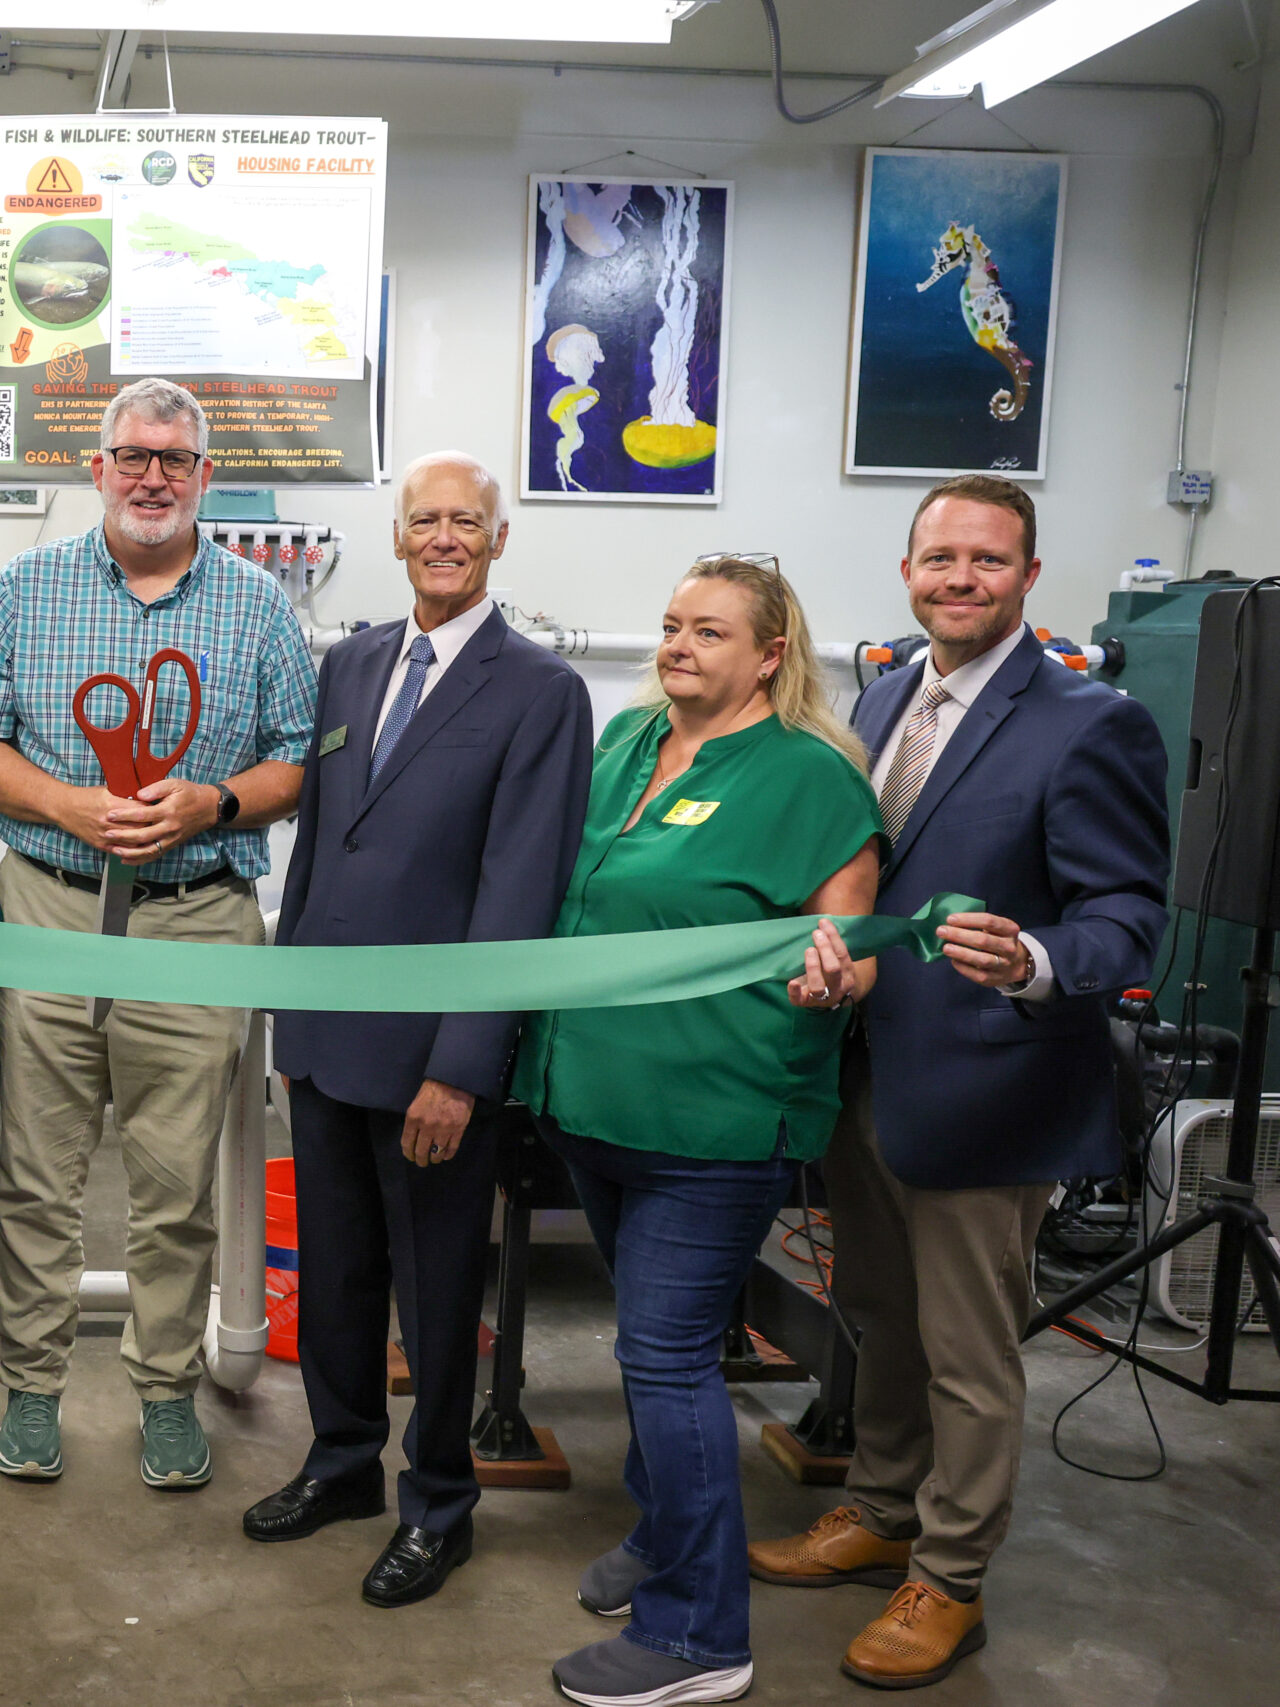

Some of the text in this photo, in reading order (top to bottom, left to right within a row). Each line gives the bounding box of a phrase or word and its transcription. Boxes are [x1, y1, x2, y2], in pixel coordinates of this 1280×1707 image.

[5, 129, 37, 143] FISH
[44, 129, 54, 143] &
[61, 129, 131, 143] WILDLIFE:
[137, 128, 216, 143] SOUTHERN
[222, 130, 310, 145] STEELHEAD
[237, 156, 374, 173] HOUSING FACILITY
[9, 197, 97, 208] ENDANGERED
[33, 384, 86, 395] SAVING
[91, 383, 117, 393] THE
[203, 382, 286, 394] STEELHEAD
[291, 385, 338, 397] TROUT
[242, 400, 273, 408] DISTRICT
[303, 402, 326, 410] SANTA
[228, 412, 257, 420] PROVIDE
[212, 424, 250, 432] SOUTHERN
[252, 424, 293, 432] STEELHEAD
[25, 450, 76, 464] GOAL:
[206, 448, 256, 457] OPULATIONS,
